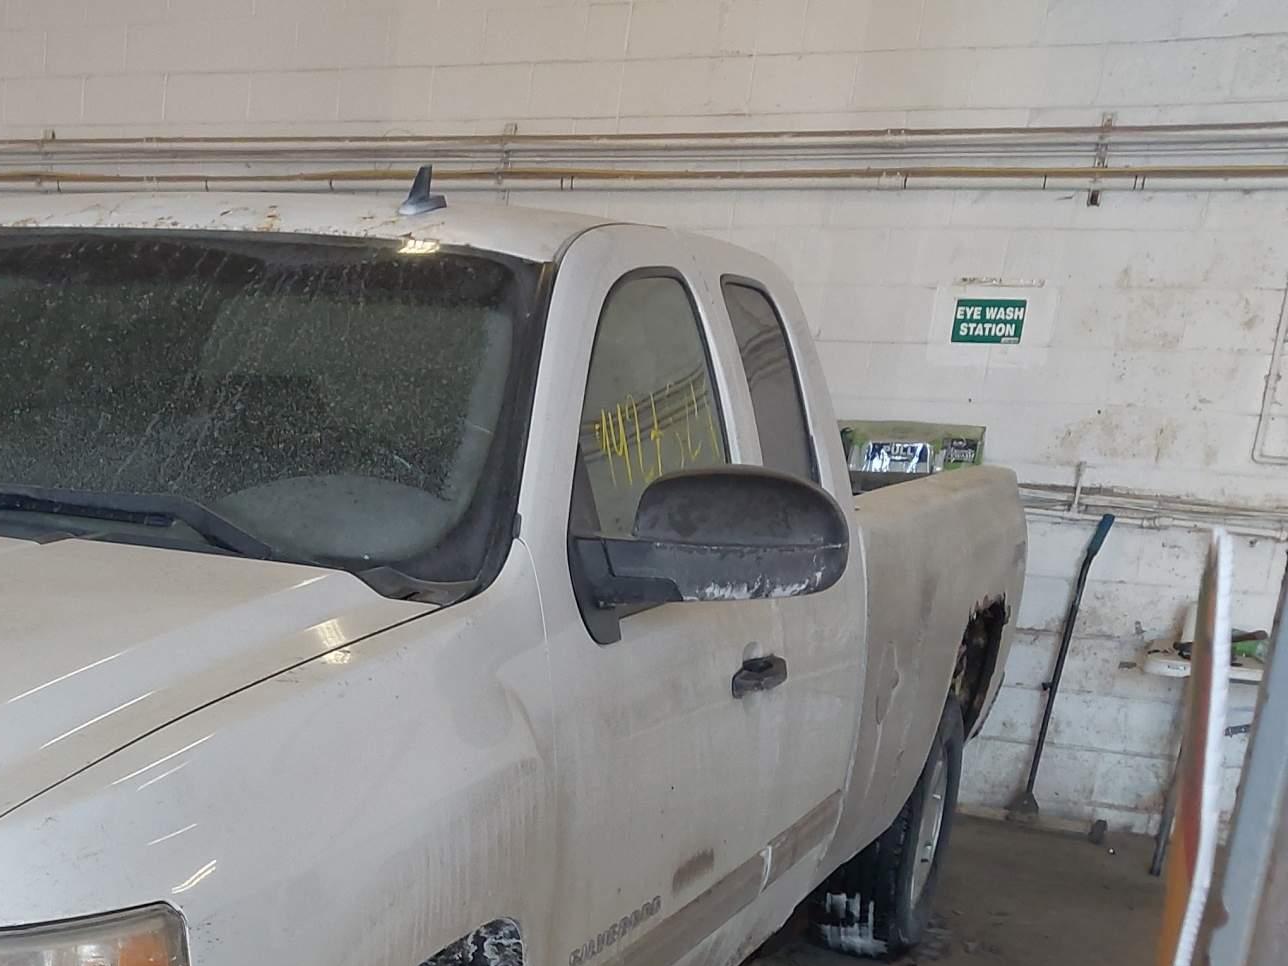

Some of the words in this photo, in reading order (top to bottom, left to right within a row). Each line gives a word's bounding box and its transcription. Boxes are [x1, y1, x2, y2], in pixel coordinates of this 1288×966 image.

[956, 306, 982, 319] EYE
[985, 306, 1025, 320] WASH
[959, 323, 1015, 336] STATION
